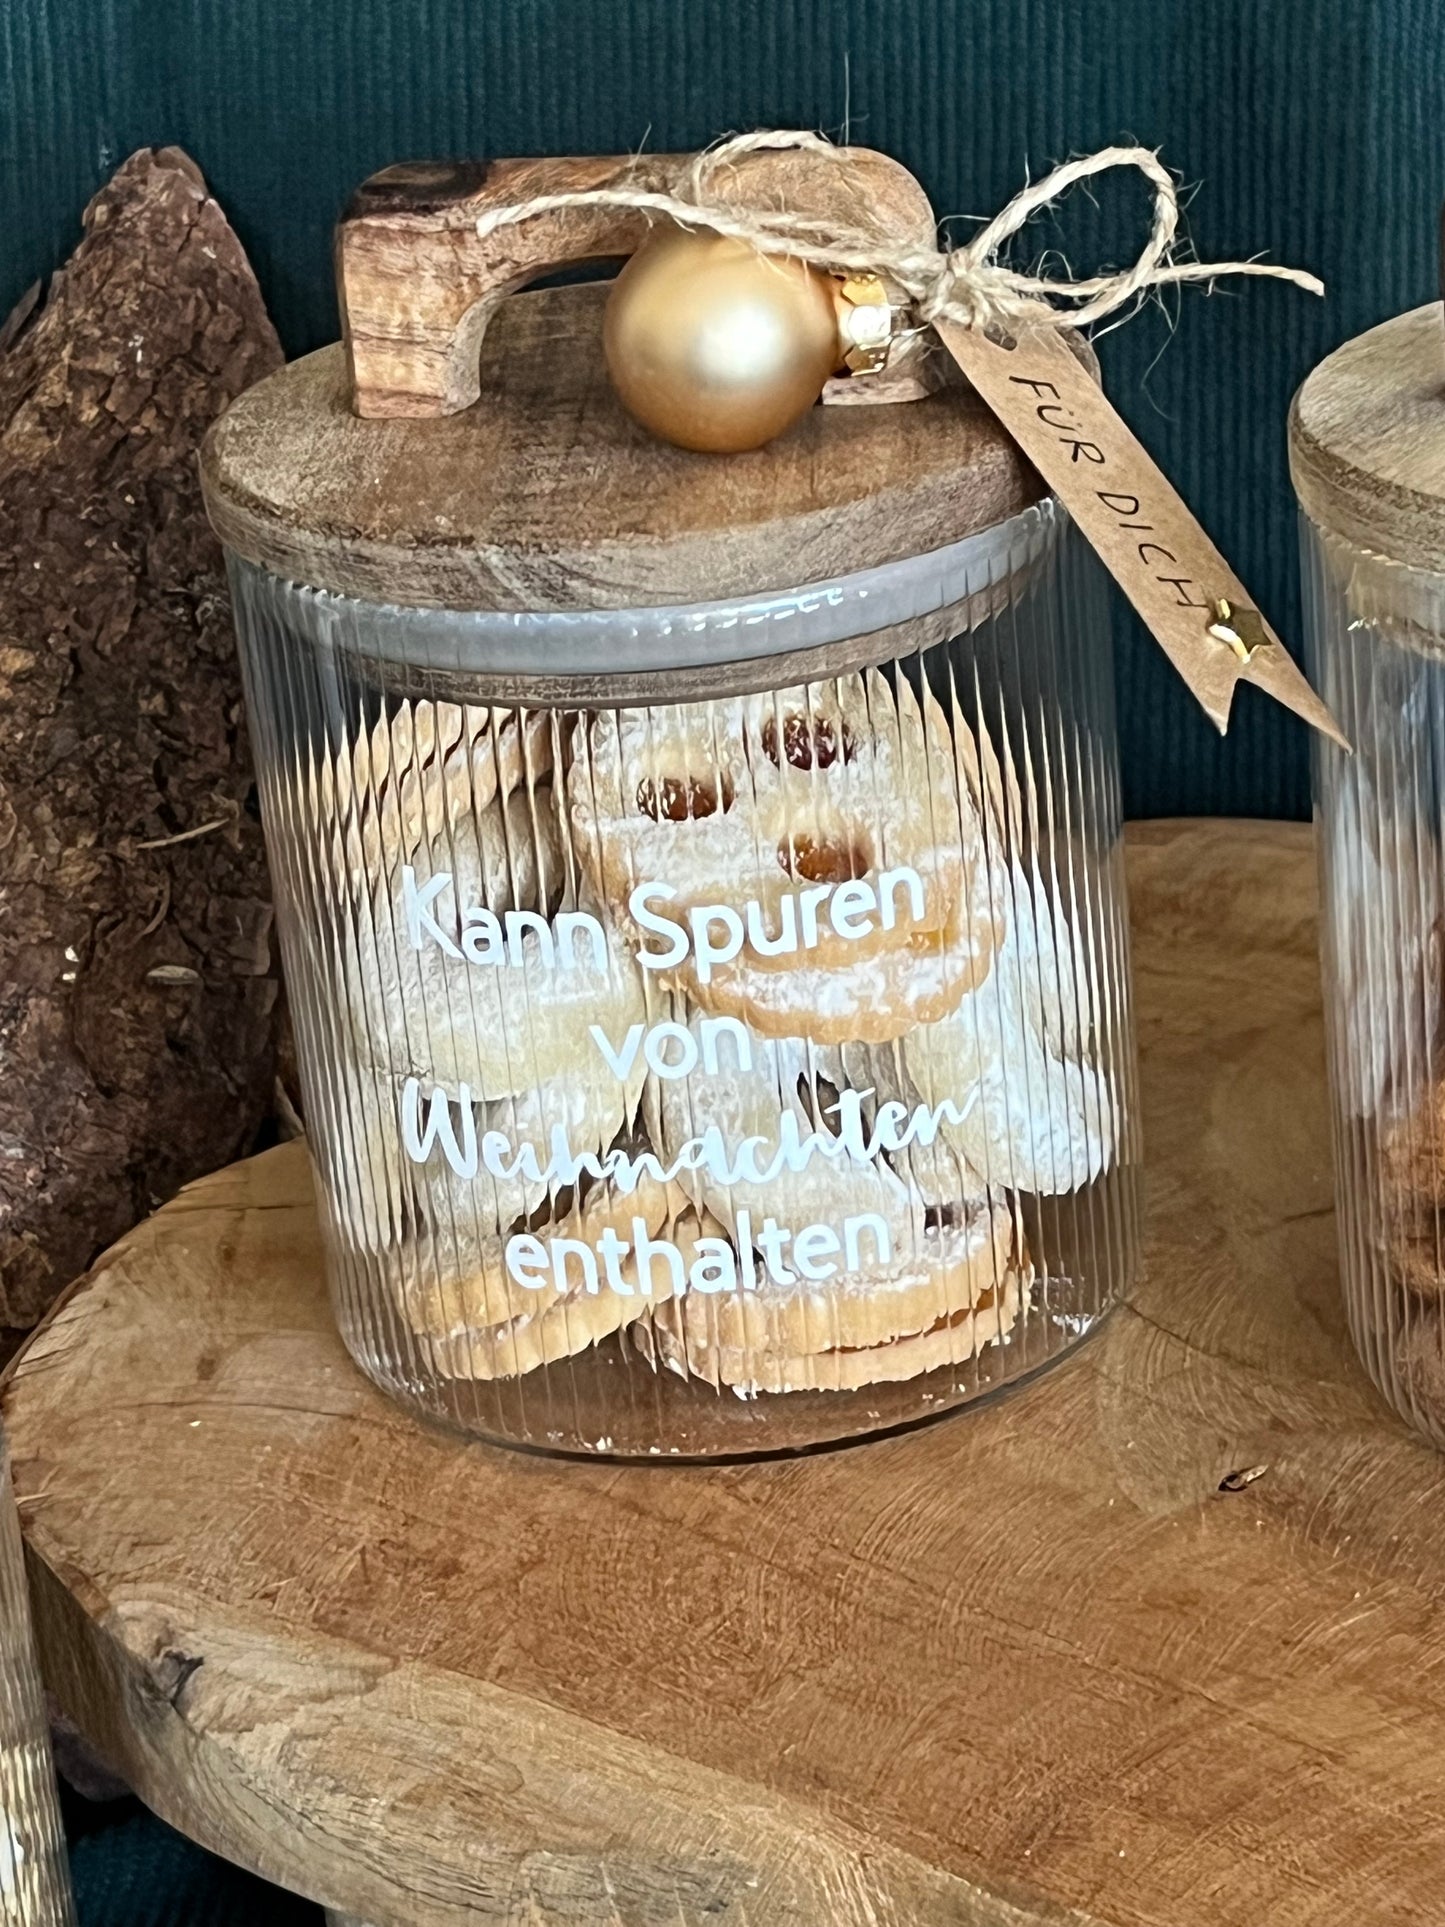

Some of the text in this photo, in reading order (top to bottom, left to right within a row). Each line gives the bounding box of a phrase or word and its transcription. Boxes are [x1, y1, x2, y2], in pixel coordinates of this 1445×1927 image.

[1008, 375, 1210, 609] FÜR DICH
[401, 864, 926, 984] Kann Spuren
[589, 1015, 753, 1081] von
[401, 1075, 980, 1192] Weihnachten
[505, 1210, 892, 1296] enthalten
